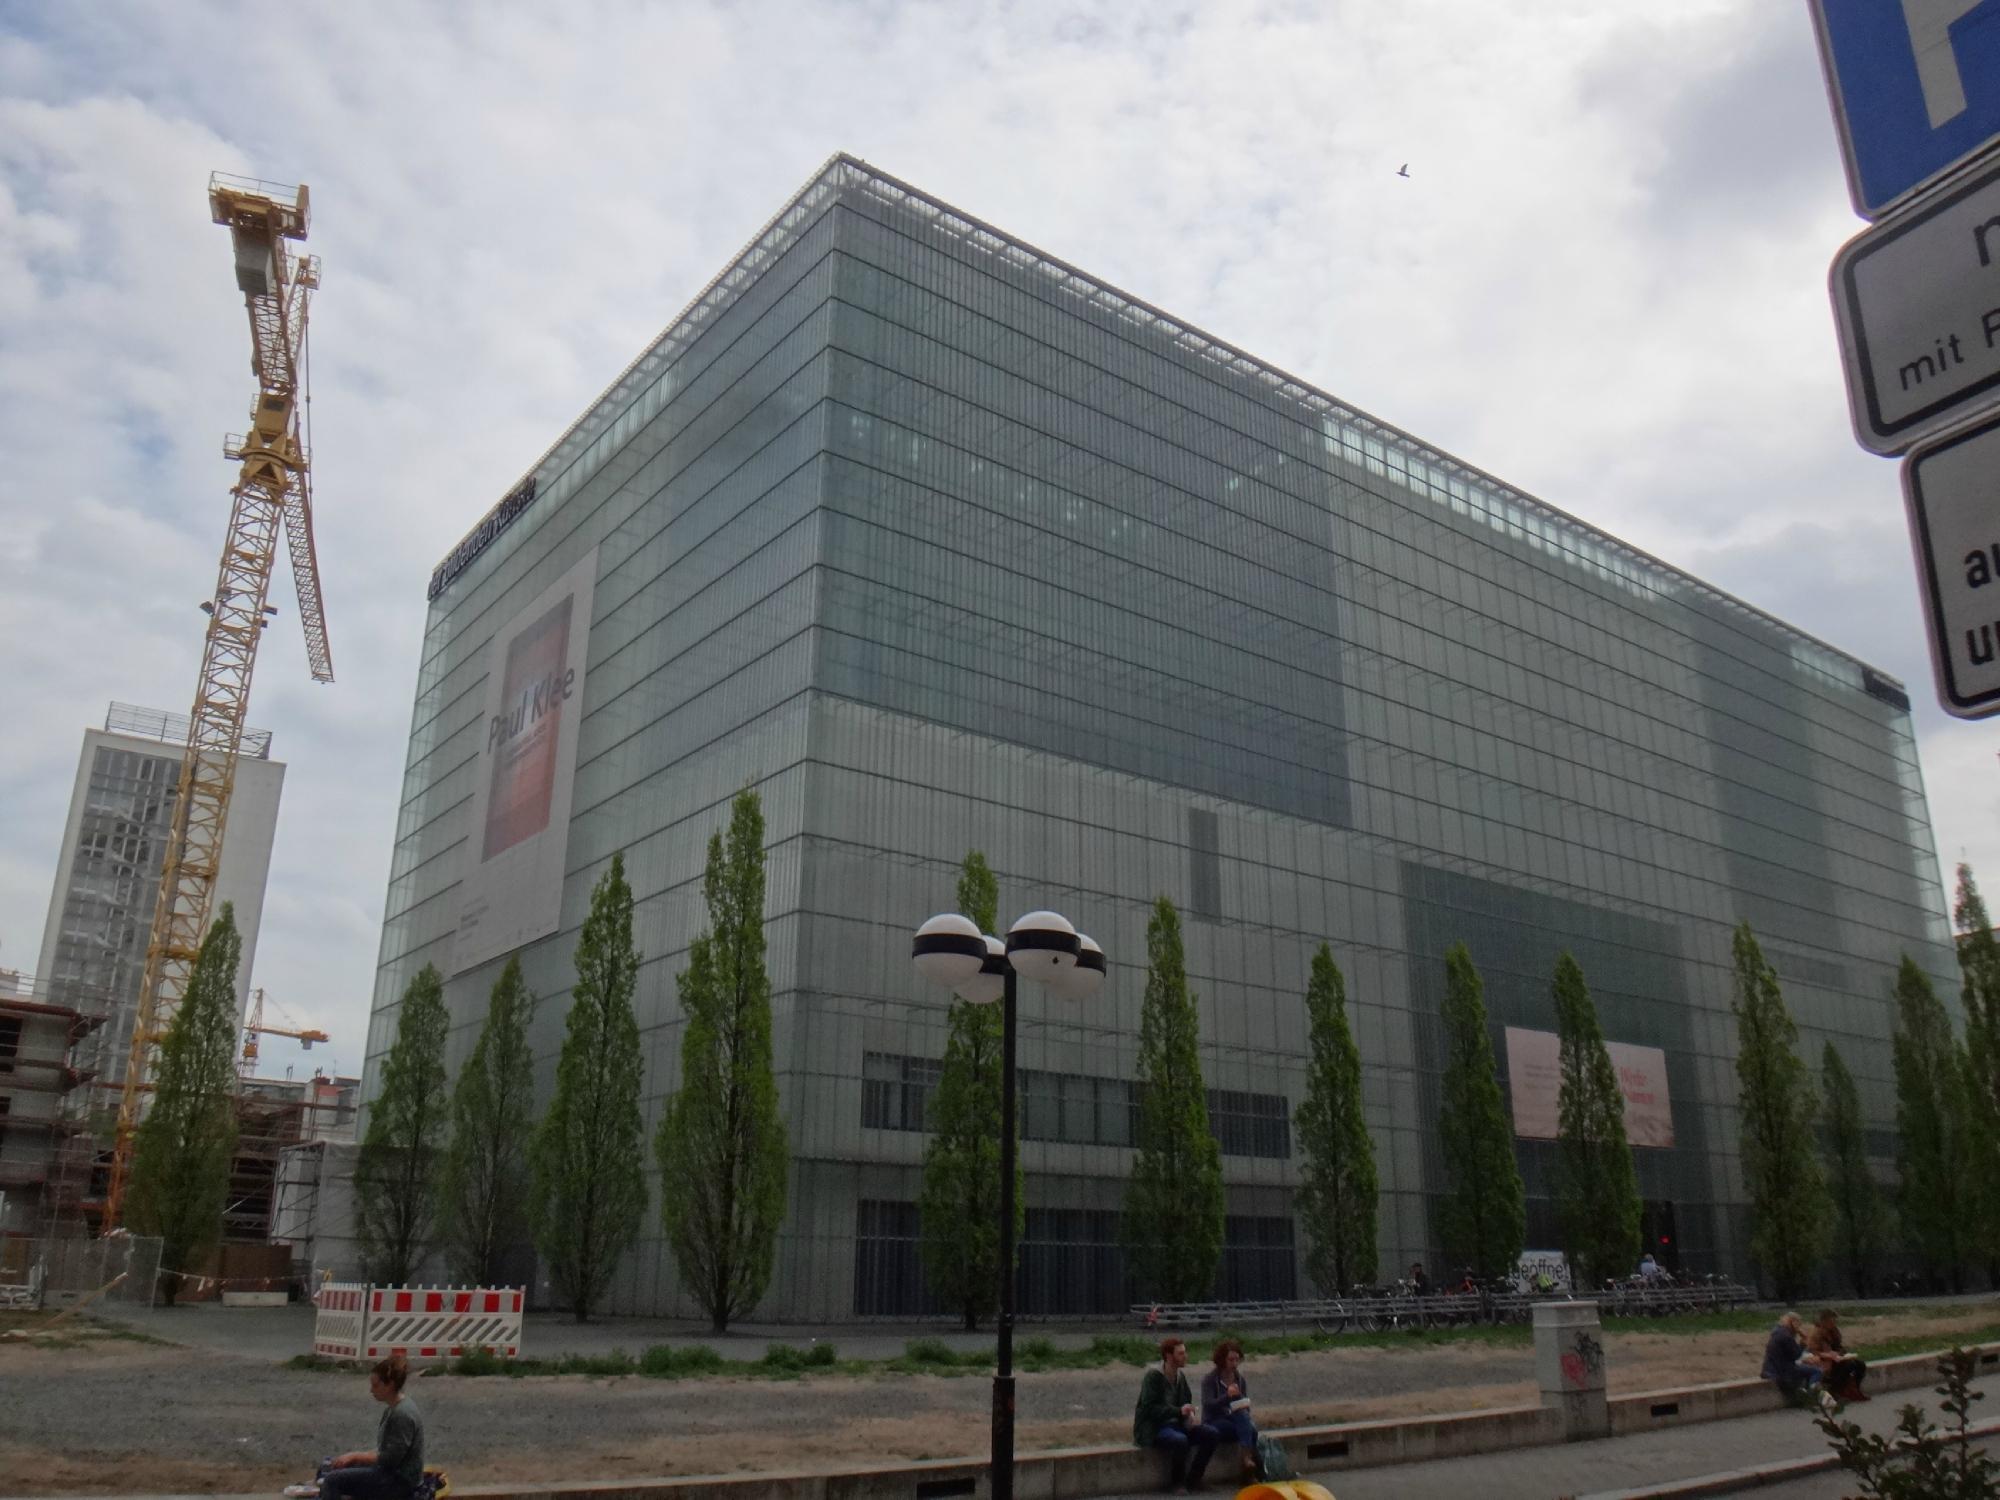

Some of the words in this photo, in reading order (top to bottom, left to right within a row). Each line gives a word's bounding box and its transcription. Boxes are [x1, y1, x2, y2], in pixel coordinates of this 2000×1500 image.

[1900, 334, 1965, 391] mit
[1965, 620, 2000, 666] u
[487, 689, 528, 755] Paul
[531, 667, 575, 724] Klee
